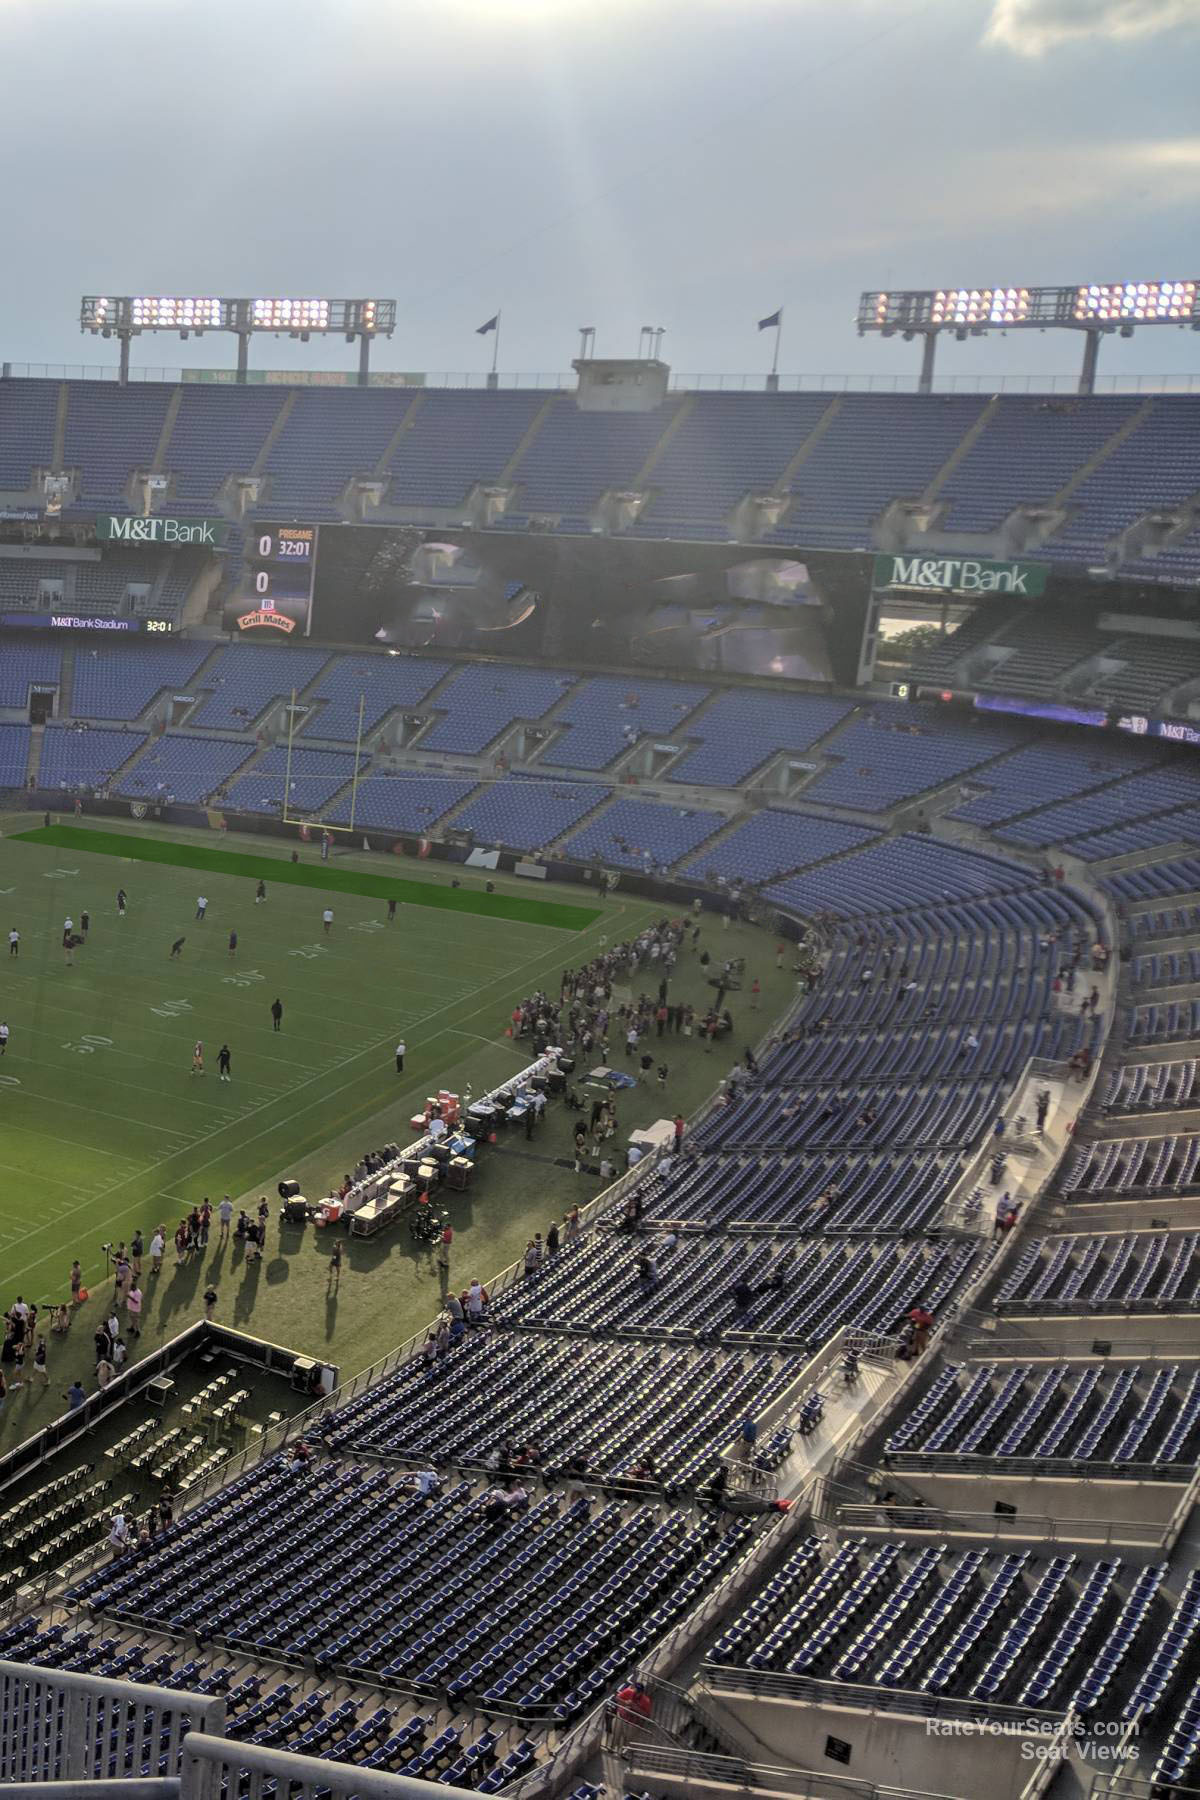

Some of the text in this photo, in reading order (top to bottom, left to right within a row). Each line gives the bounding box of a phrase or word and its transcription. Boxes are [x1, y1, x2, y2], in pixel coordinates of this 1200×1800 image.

[109, 516, 215, 543] M&T Bank
[279, 528, 313, 540] PREGAME
[260, 535, 311, 556] 0 32:01
[256, 572, 269, 593] 0
[890, 556, 1028, 593] M&T Bank
[51, 616, 128, 629] M&T Bank Stadium
[147, 621, 172, 632] 32:01
[264, 614, 290, 629] Mates
